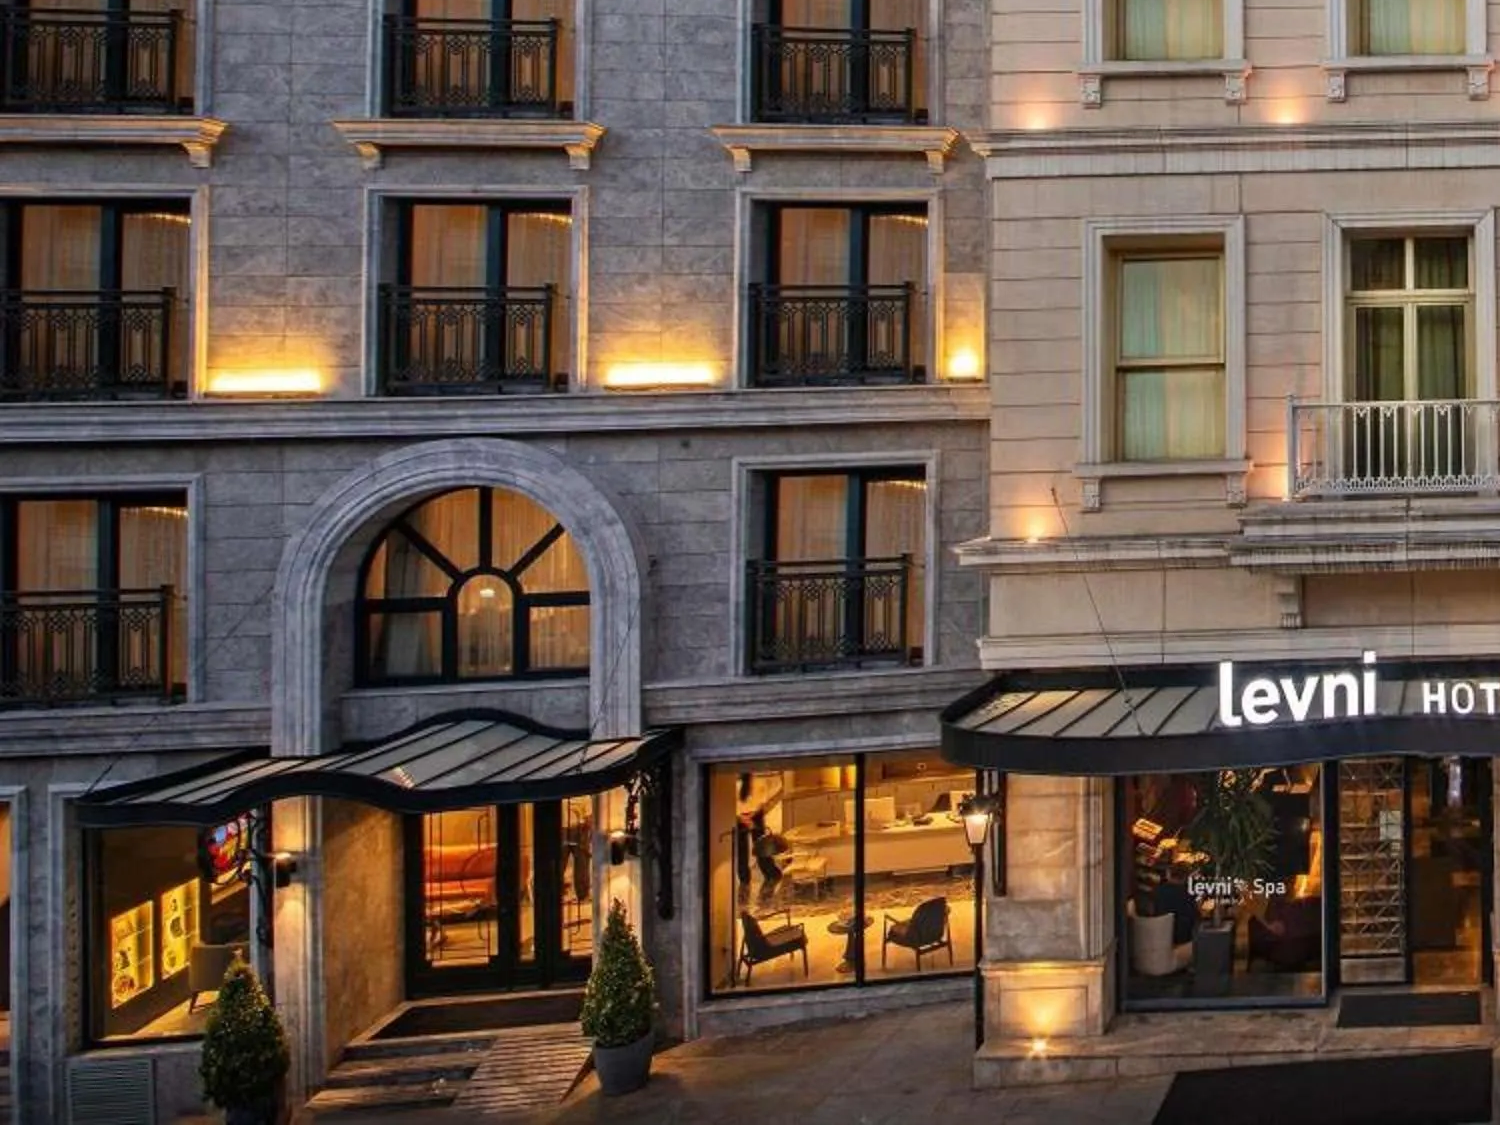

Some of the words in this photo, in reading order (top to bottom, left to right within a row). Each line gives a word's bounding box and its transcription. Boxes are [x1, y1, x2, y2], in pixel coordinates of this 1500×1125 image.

[1218, 650, 1378, 727] levni
[1187, 876, 1232, 895] levni
[1253, 878, 1286, 899] Spa
